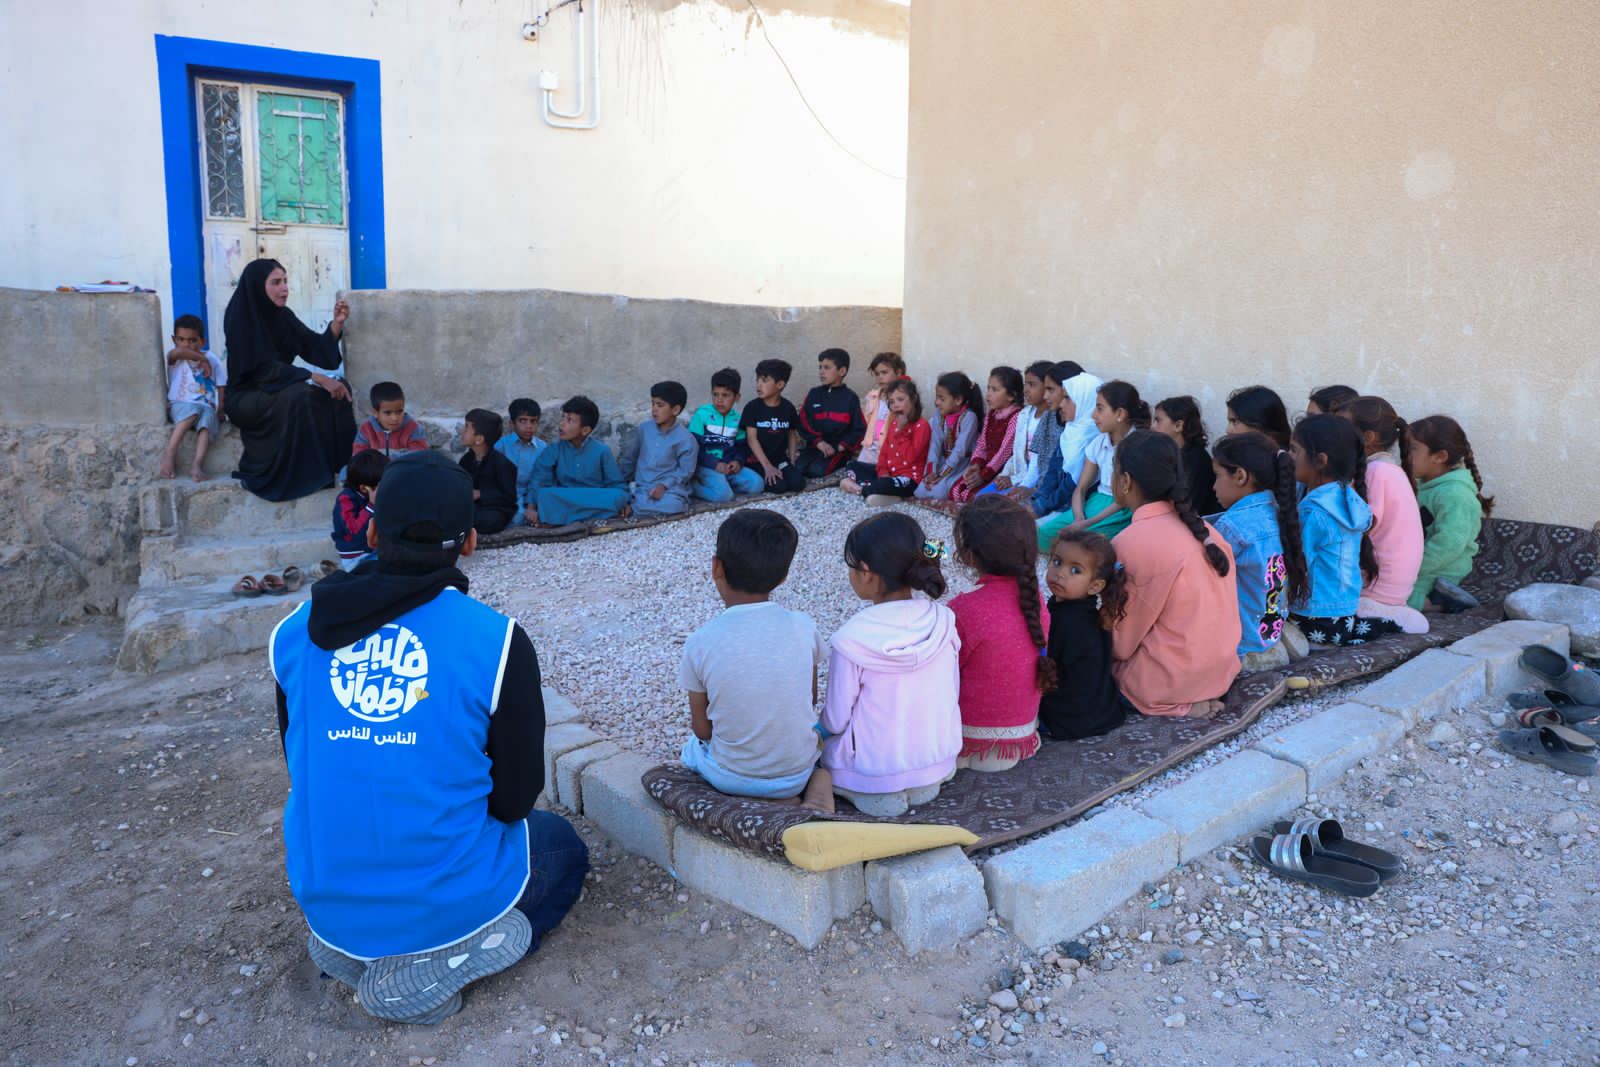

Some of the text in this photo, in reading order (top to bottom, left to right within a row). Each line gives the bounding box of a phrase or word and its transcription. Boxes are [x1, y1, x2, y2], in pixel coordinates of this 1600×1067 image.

[329, 626, 428, 678] قلبي
[327, 726, 417, 745] الناس للناس
